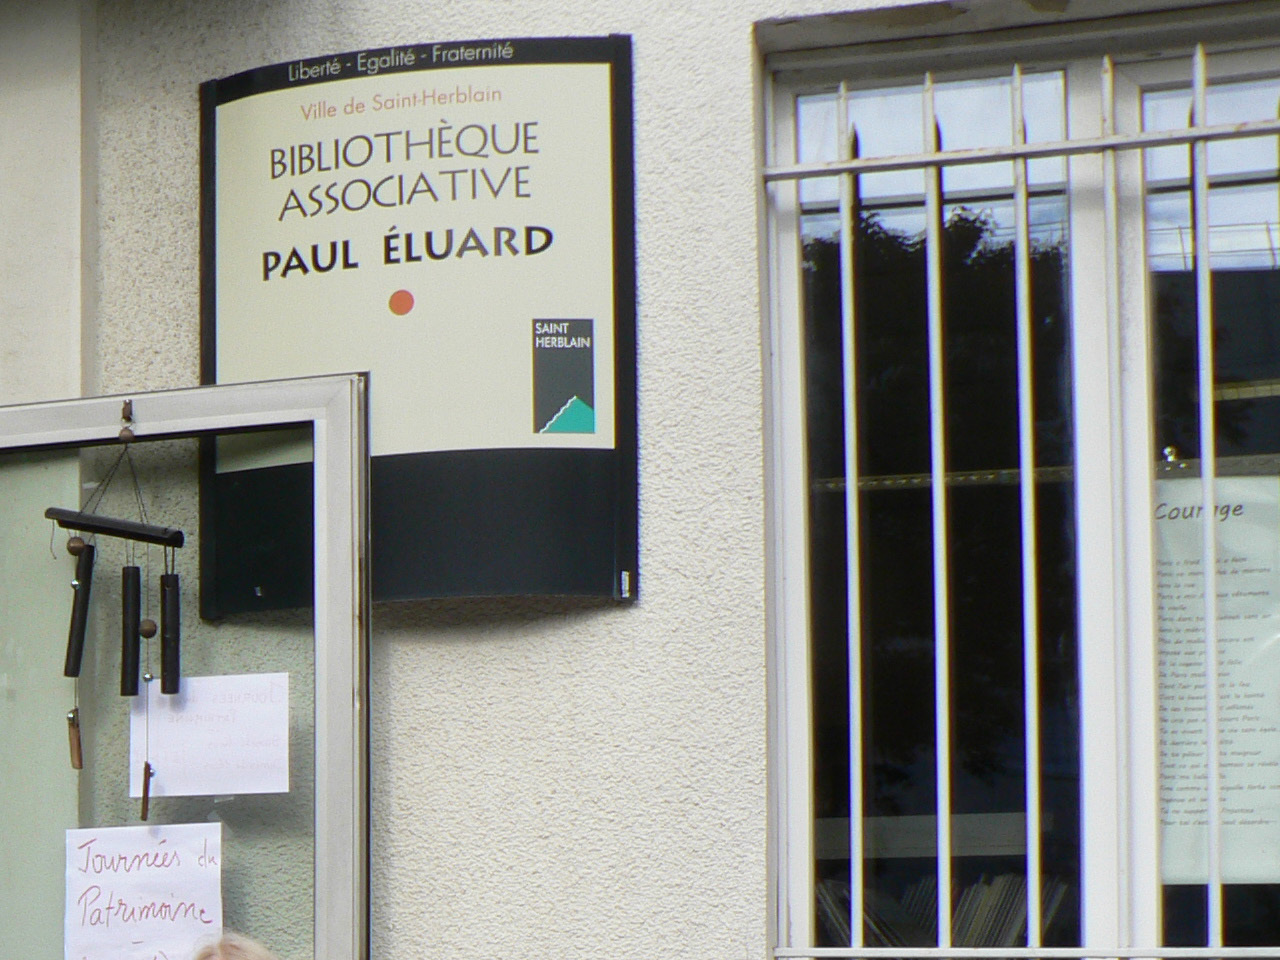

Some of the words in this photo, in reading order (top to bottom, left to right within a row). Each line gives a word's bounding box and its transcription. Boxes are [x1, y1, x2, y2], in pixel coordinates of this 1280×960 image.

[288, 57, 341, 82] Liberté
[357, 49, 416, 74] Egalité
[431, 42, 513, 64] Fraternité
[300, 100, 338, 121] Ville
[343, 97, 366, 115] de
[372, 85, 503, 114] Saint-Herblain
[271, 119, 540, 180] BIBLIOTHÈQUE
[278, 165, 531, 222] ASSOCIATIVE
[262, 240, 359, 281] PAUL
[383, 226, 554, 266] ÉLUARD
[535, 322, 569, 334] SAINT
[535, 335, 591, 348] HERBLAIN
[77, 838, 181, 874] Journées
[197, 842, 218, 868] du
[77, 885, 214, 928] Patrimoine
